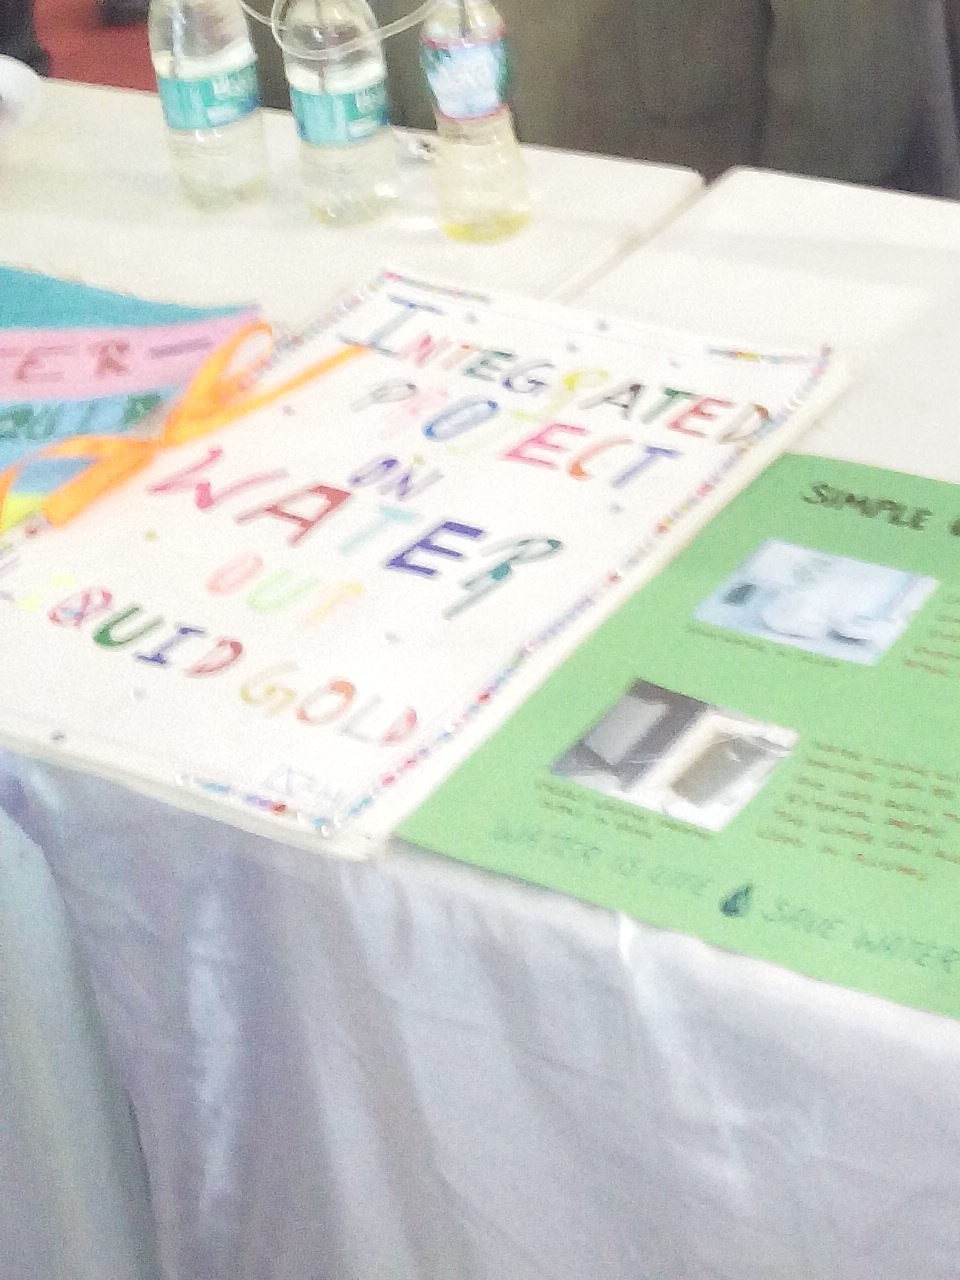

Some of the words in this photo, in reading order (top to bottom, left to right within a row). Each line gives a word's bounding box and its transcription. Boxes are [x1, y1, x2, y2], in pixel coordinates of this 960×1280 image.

[339, 293, 783, 444] INTEGRATED
[351, 376, 684, 488] PROJECT
[347, 455, 446, 502] ON
[804, 482, 934, 532] SIMPLE
[148, 446, 564, 620] WATER
[239, 660, 418, 747] GOLD
[760, 897, 843, 940] SAVE
[852, 925, 960, 974] WATER
